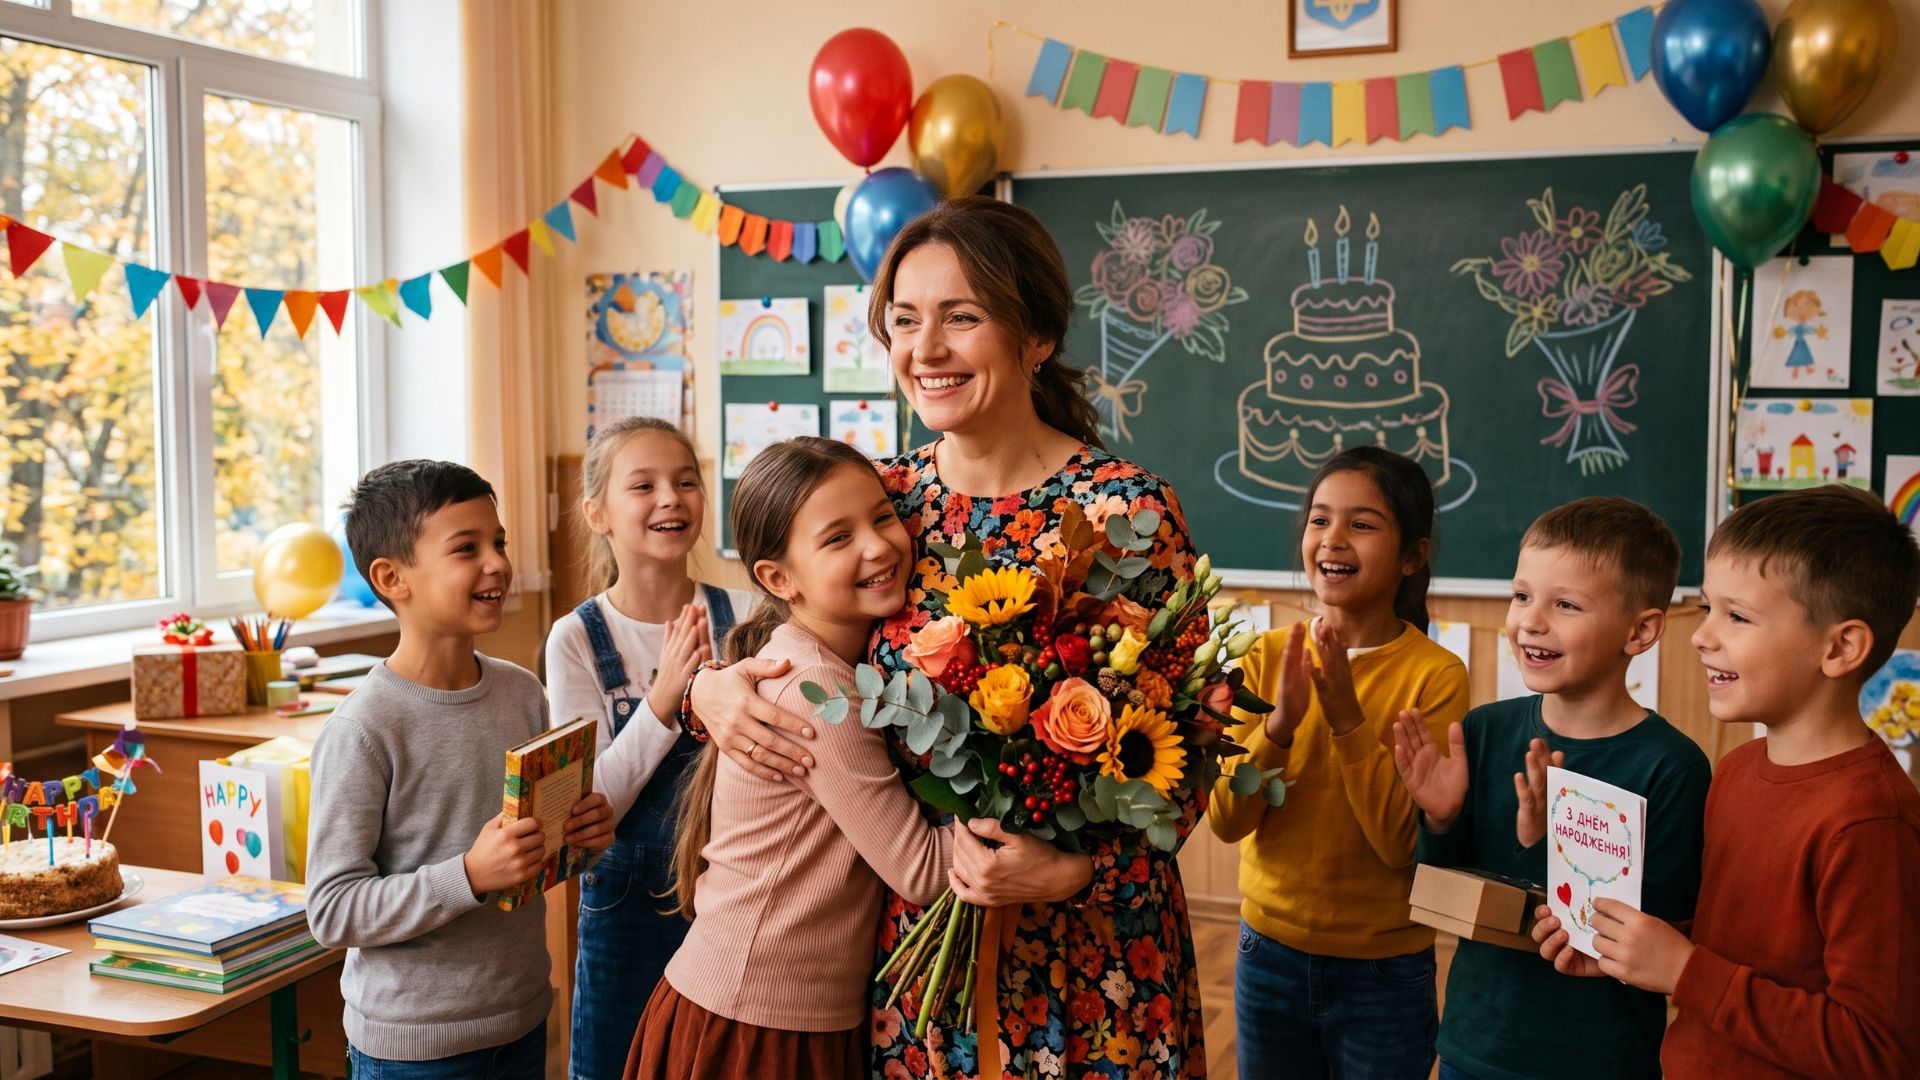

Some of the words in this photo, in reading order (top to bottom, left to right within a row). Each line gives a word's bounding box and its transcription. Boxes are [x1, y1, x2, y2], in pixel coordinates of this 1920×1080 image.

[3, 767, 100, 805] HAPPY
[204, 780, 261, 818] HAPPY
[1566, 807, 1573, 820] З
[1577, 812, 1609, 834] ДНЁМ
[1555, 823, 1631, 863] НАРОДЖЕННЯ!
